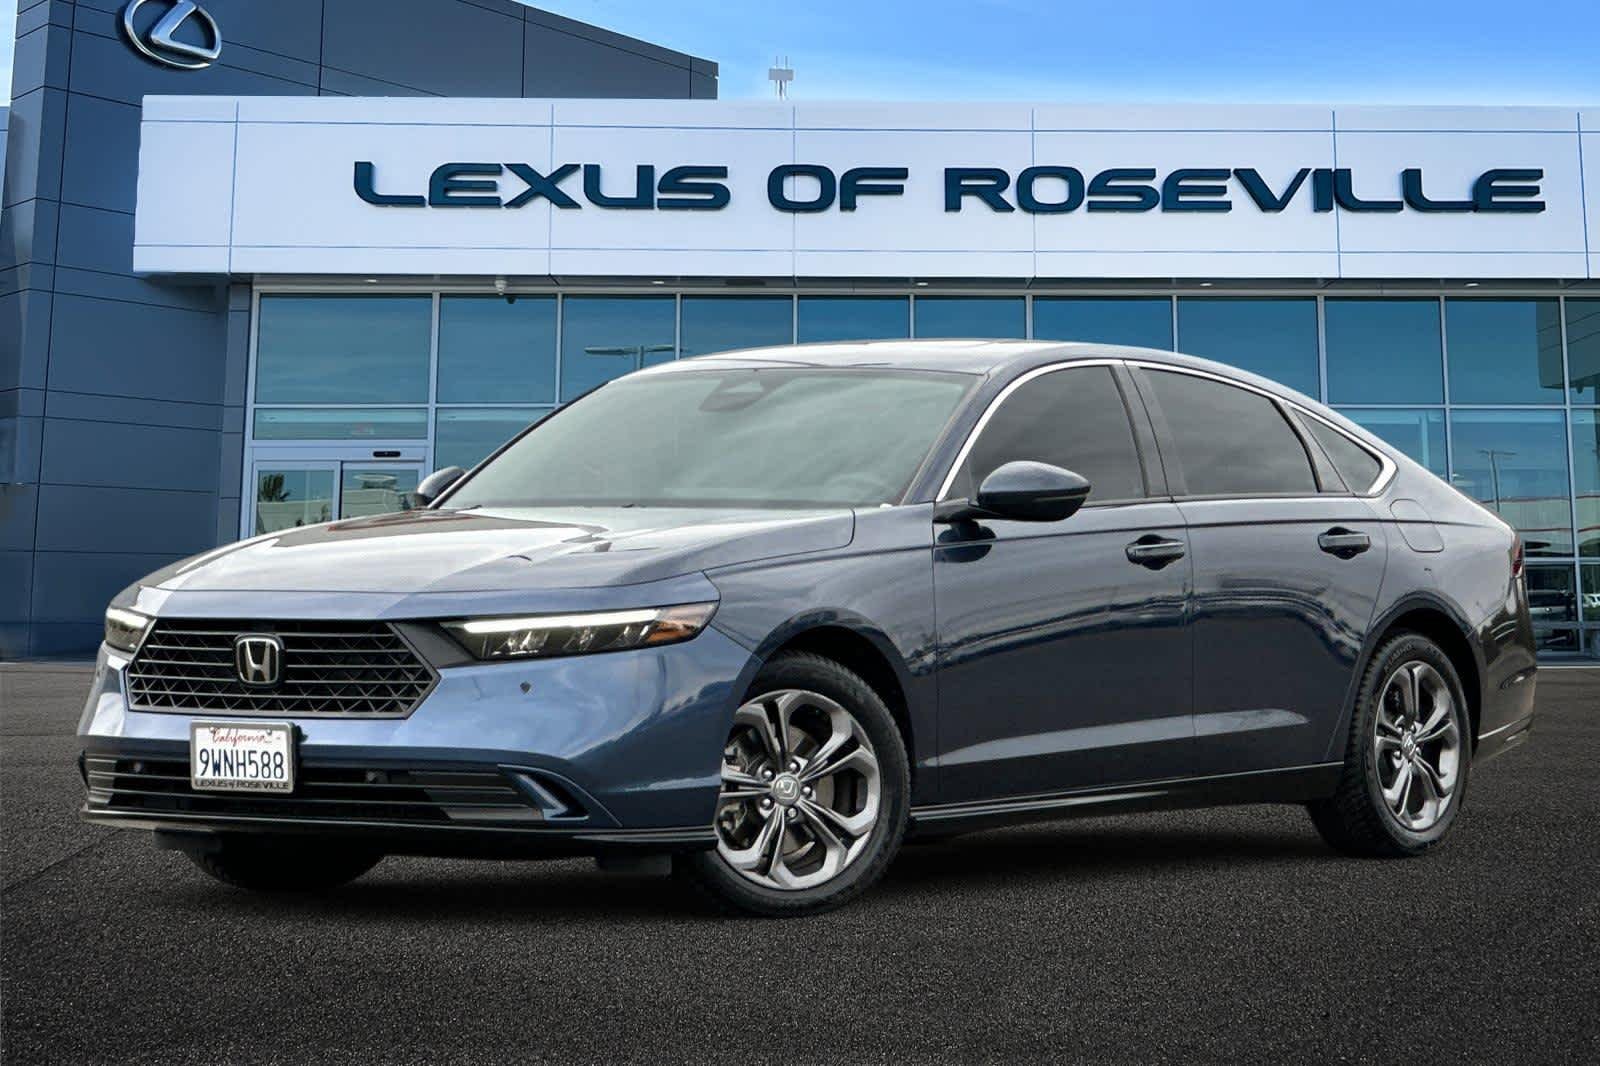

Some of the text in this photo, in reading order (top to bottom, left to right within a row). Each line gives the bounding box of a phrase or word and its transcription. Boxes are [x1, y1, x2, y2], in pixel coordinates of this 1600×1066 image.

[353, 161, 1546, 216] LEXUS OF ROSEVILLE
[212, 727, 267, 747] California
[199, 748, 285, 779] 9WNH588
